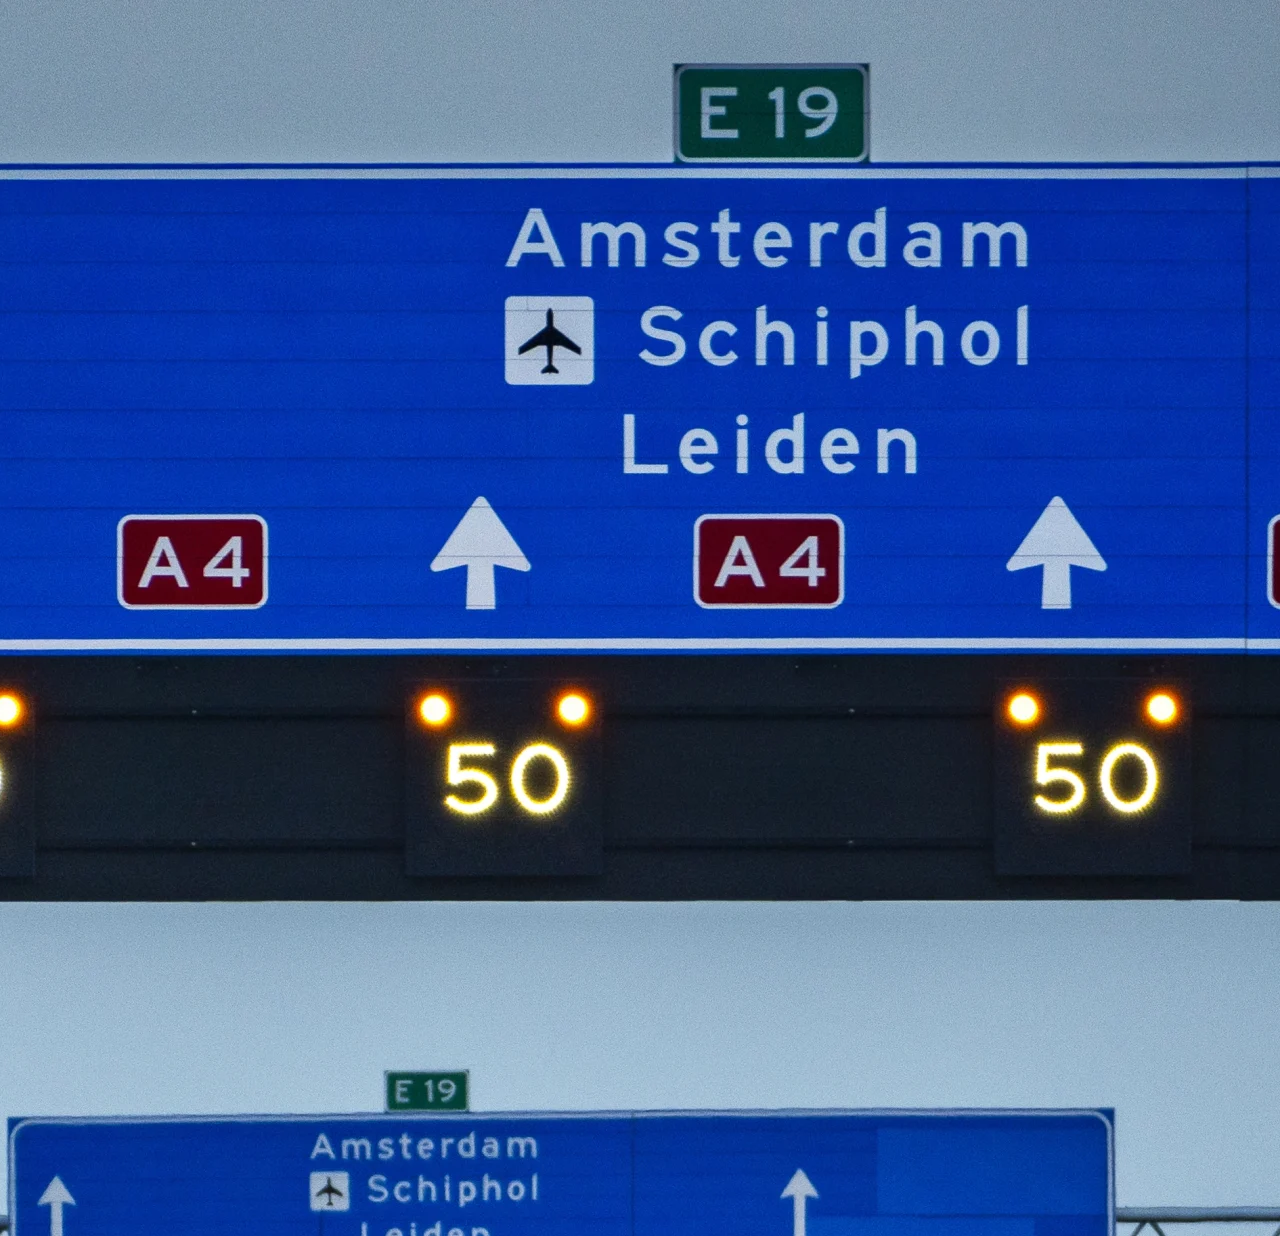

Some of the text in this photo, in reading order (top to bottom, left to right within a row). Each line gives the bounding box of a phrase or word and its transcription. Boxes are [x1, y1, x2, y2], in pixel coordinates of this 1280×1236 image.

[699, 85, 840, 140] E 19
[504, 205, 1029, 270] Amsterdam
[637, 303, 1030, 380] Schiphol
[622, 411, 918, 476] Leiden
[136, 534, 251, 589] A4
[712, 534, 827, 589] A4
[442, 739, 573, 818] 50
[1032, 739, 1161, 817] 50
[393, 1077, 458, 1105] E 19
[309, 1130, 539, 1161] Amsterdam
[366, 1172, 539, 1209] Schiphol
